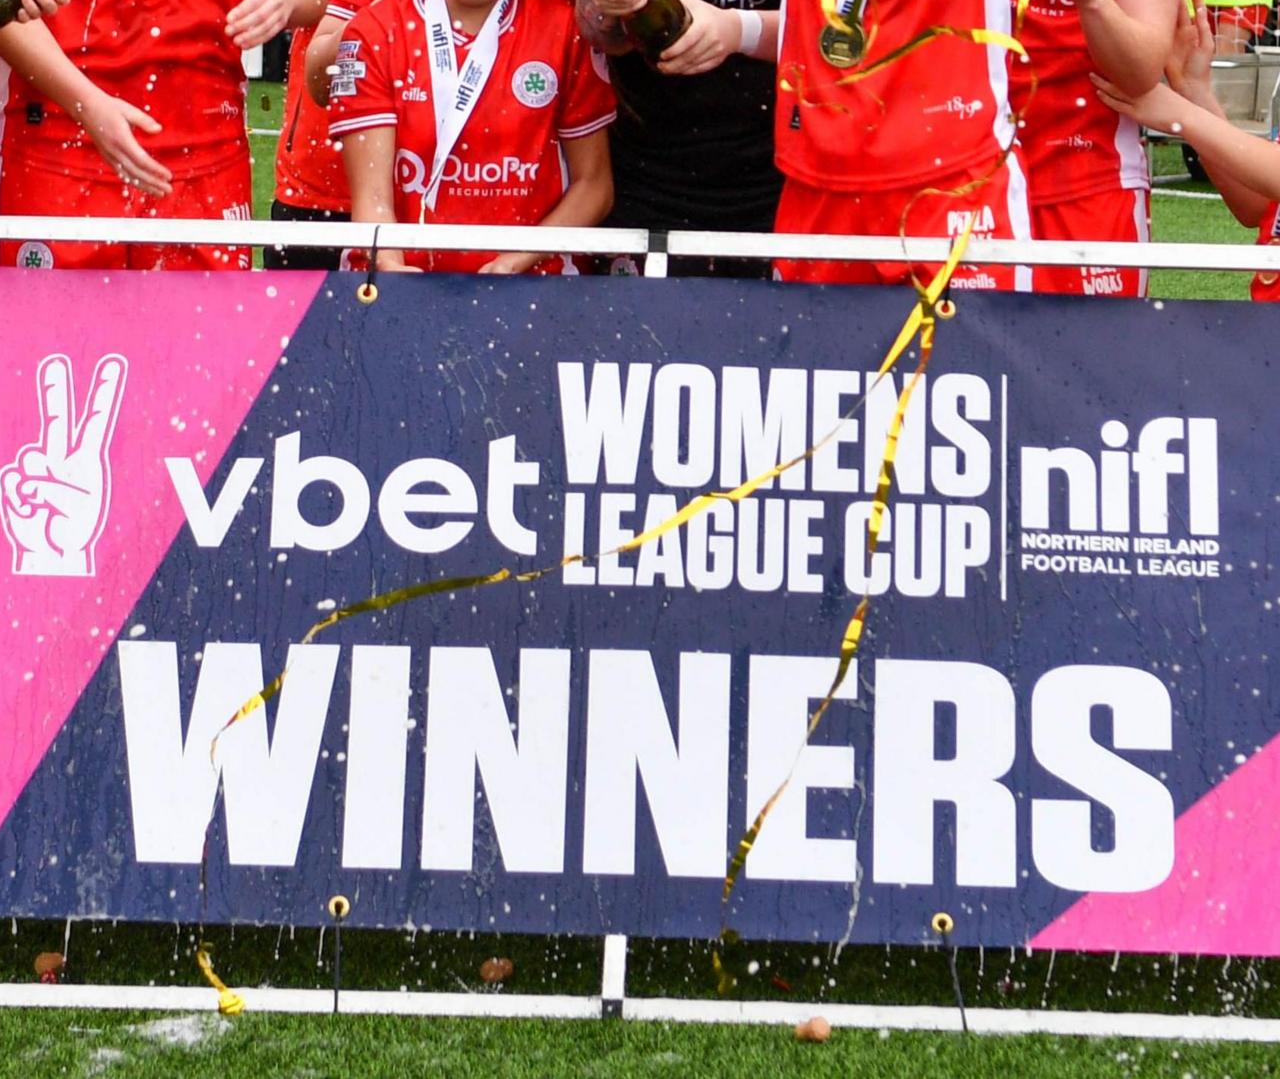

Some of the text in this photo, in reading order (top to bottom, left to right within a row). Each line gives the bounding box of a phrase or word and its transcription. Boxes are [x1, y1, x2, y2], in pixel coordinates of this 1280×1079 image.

[432, 23, 449, 48] nifl
[455, 84, 475, 112] nifl
[449, 186, 534, 197] RECRUITMEN
[1082, 274, 1123, 295] WORKS
[557, 362, 992, 498] WOMENS
[1021, 417, 1219, 536] nifl
[164, 430, 539, 556] vbet
[562, 492, 991, 598] LEAGUE CUP
[1021, 532, 1220, 556] NORTHERN IRELAND
[1021, 554, 1220, 578] FOOTBALL LEAGUE
[117, 638, 1176, 893] WINNERS
